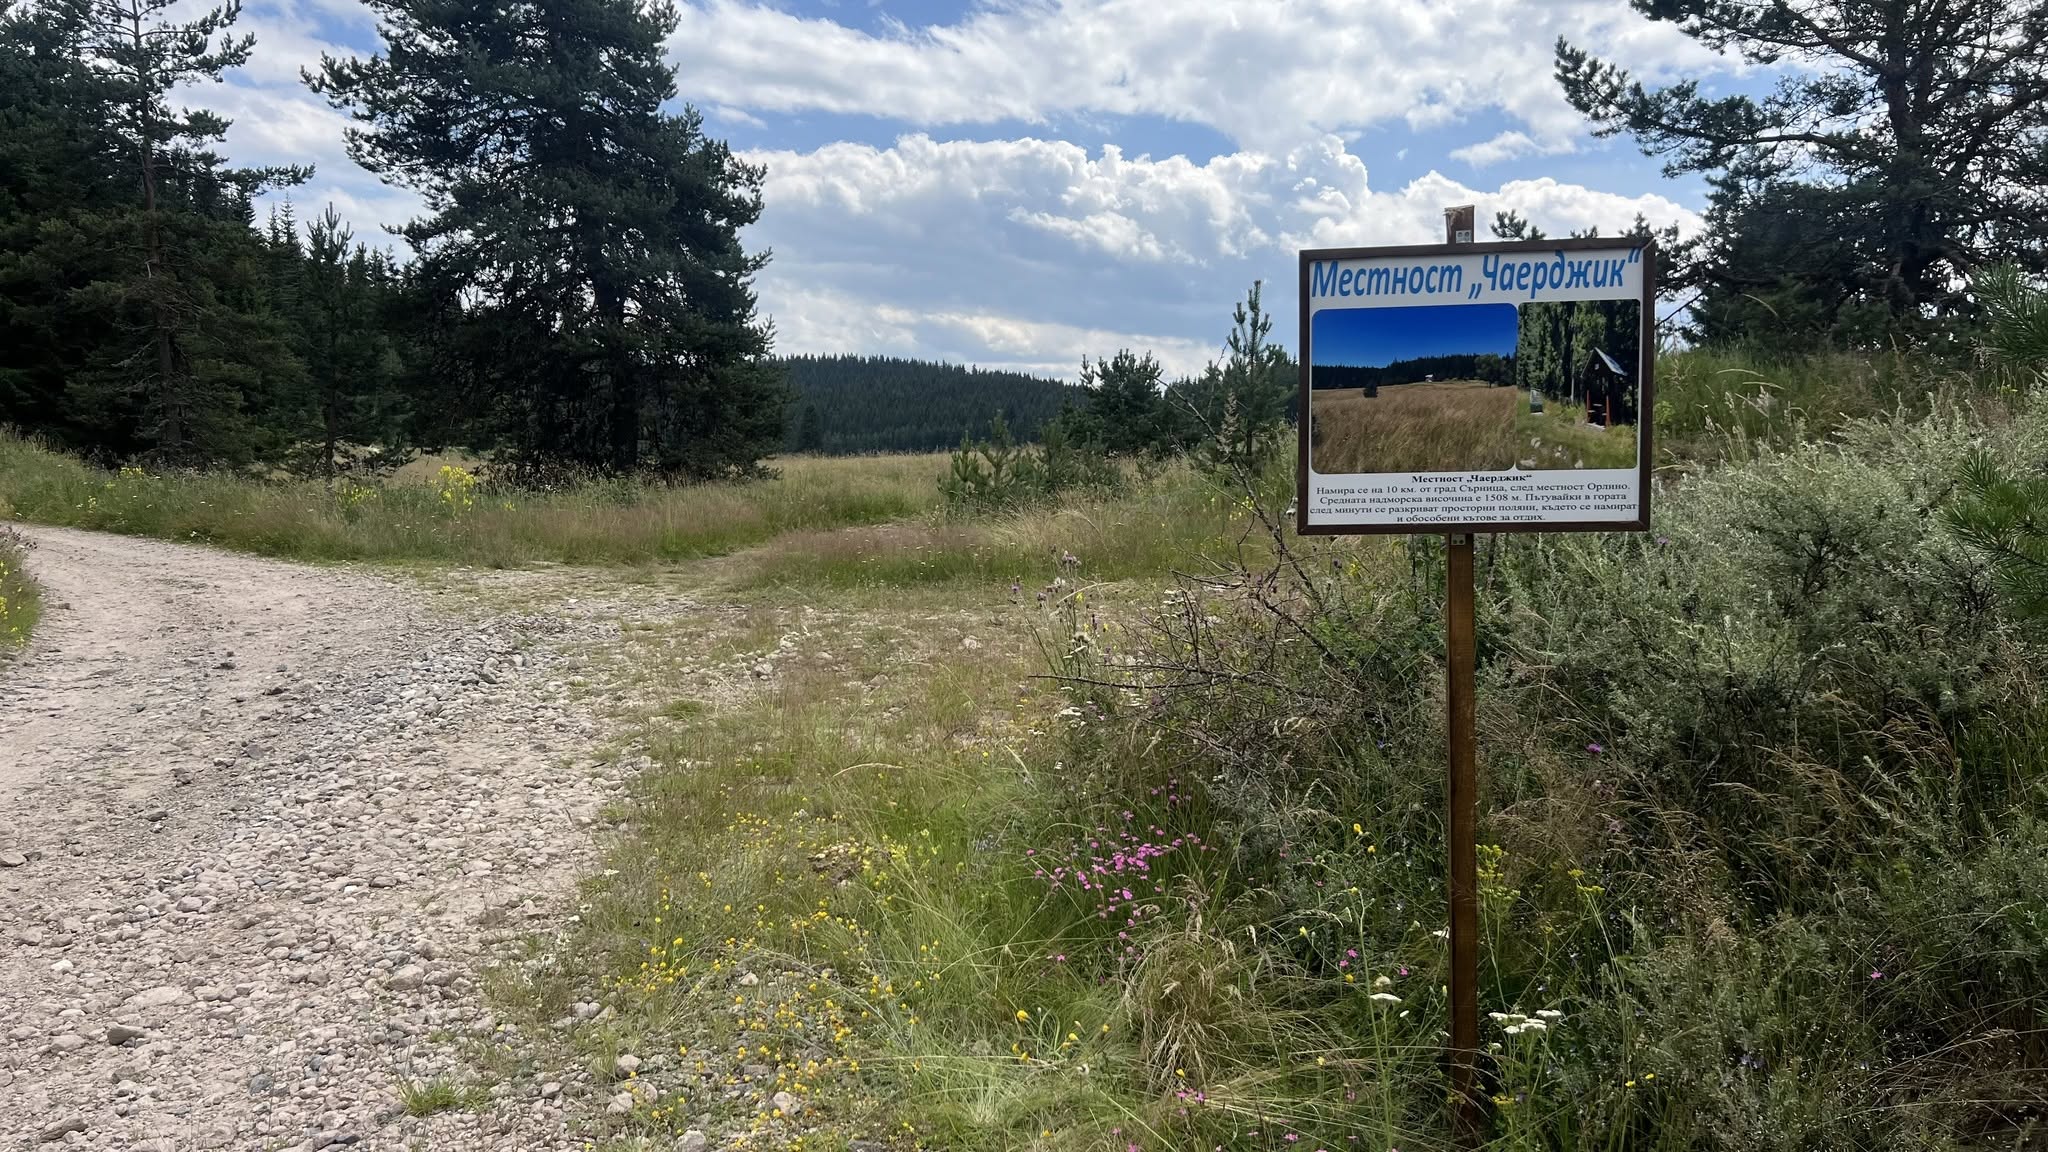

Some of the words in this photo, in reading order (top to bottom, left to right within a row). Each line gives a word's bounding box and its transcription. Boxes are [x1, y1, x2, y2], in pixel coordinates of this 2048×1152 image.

[1311, 261, 1463, 297] Местност
[1316, 487, 1354, 495] Намира
[1459, 485, 1508, 494] Сърница,
[1587, 482, 1630, 491] Орлино.
[1320, 497, 1366, 505] Средната
[1525, 493, 1581, 502] Пътувайки
[1335, 507, 1372, 515] минути
[1389, 506, 1438, 514] разкриват
[1442, 506, 1496, 514] просторни
